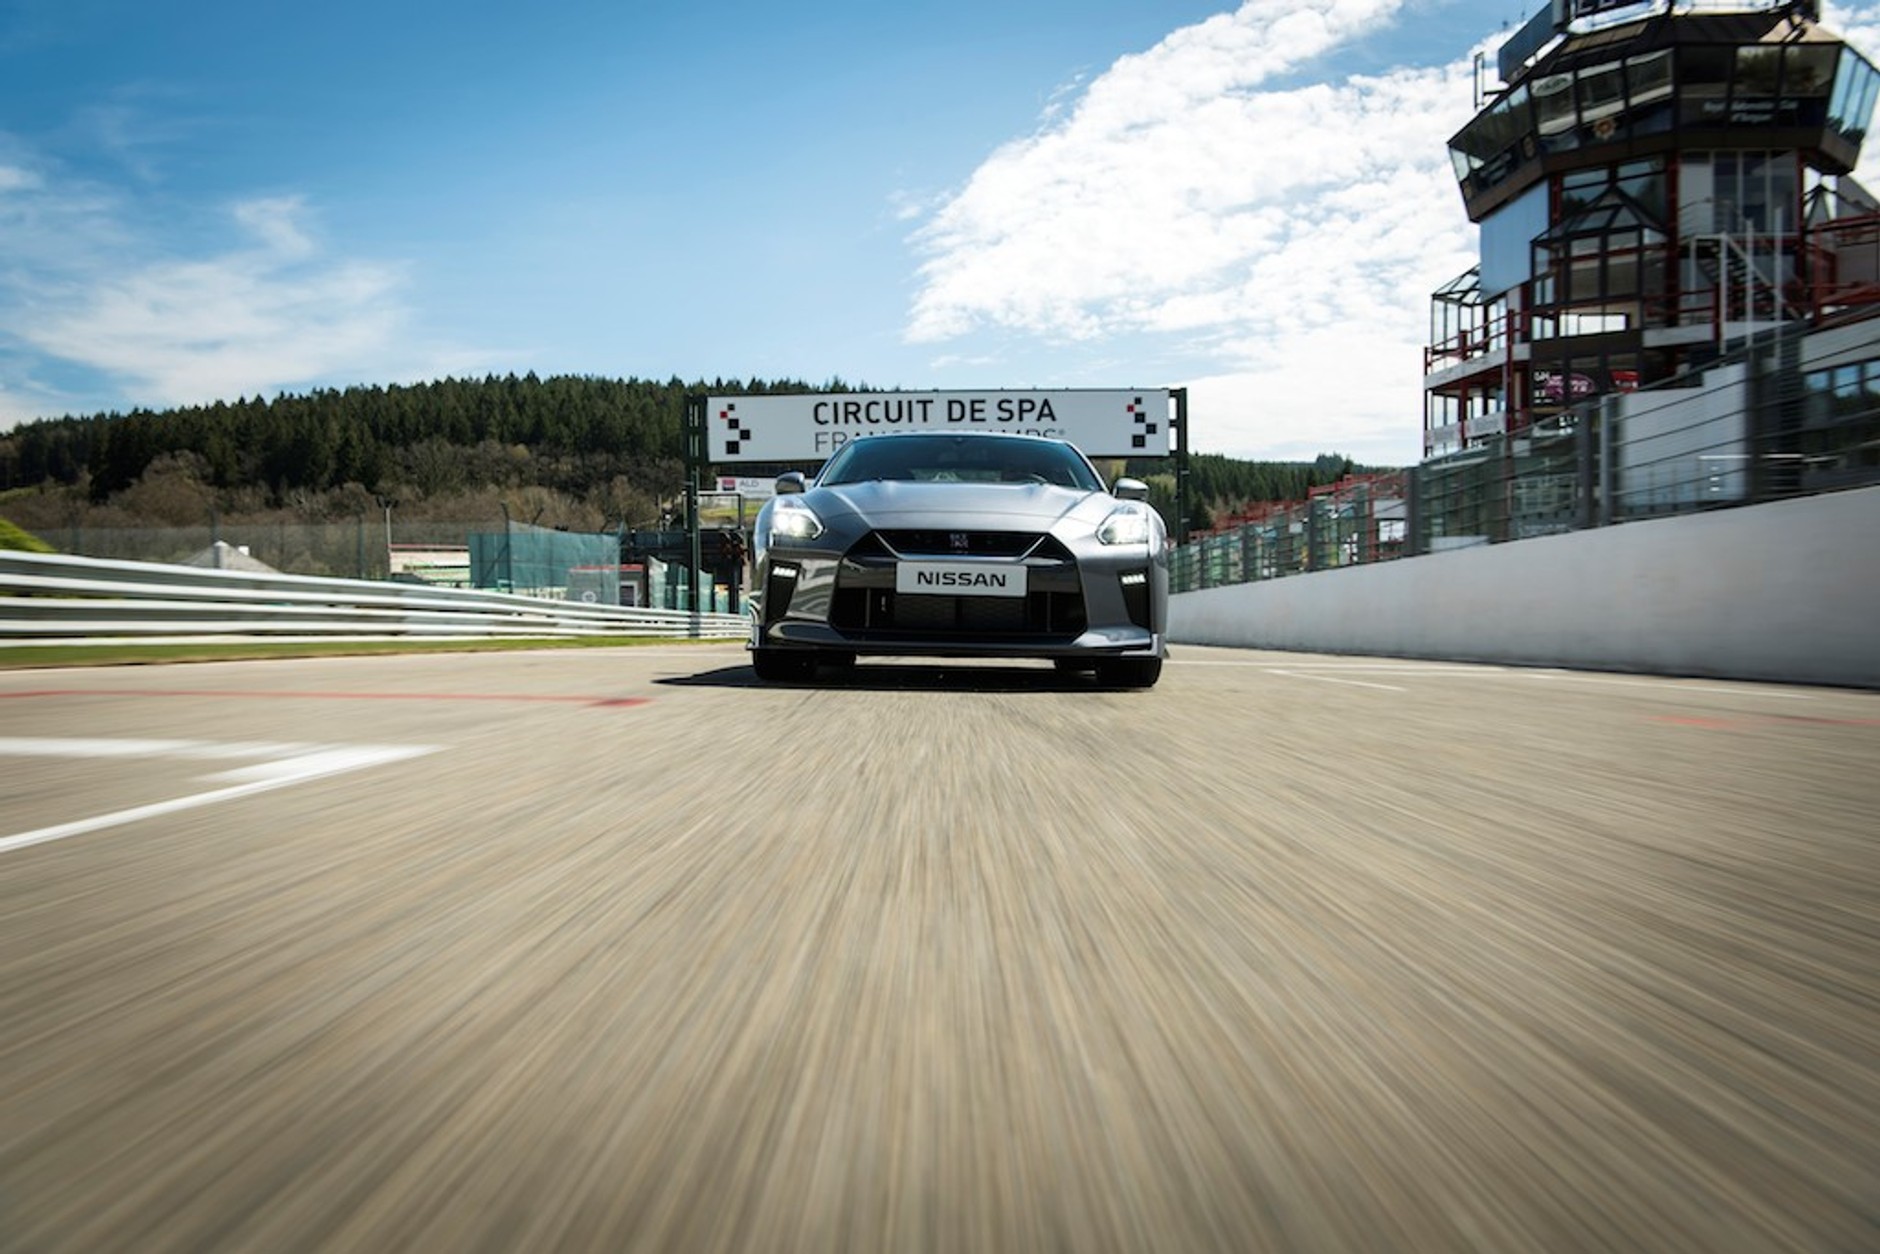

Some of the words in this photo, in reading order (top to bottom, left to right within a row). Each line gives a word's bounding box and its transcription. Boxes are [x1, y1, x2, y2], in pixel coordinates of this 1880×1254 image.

[813, 399, 934, 425] CIRCUIT
[947, 399, 987, 423] DE
[997, 398, 1057, 422] SPA
[917, 571, 1006, 588] NISSAN
